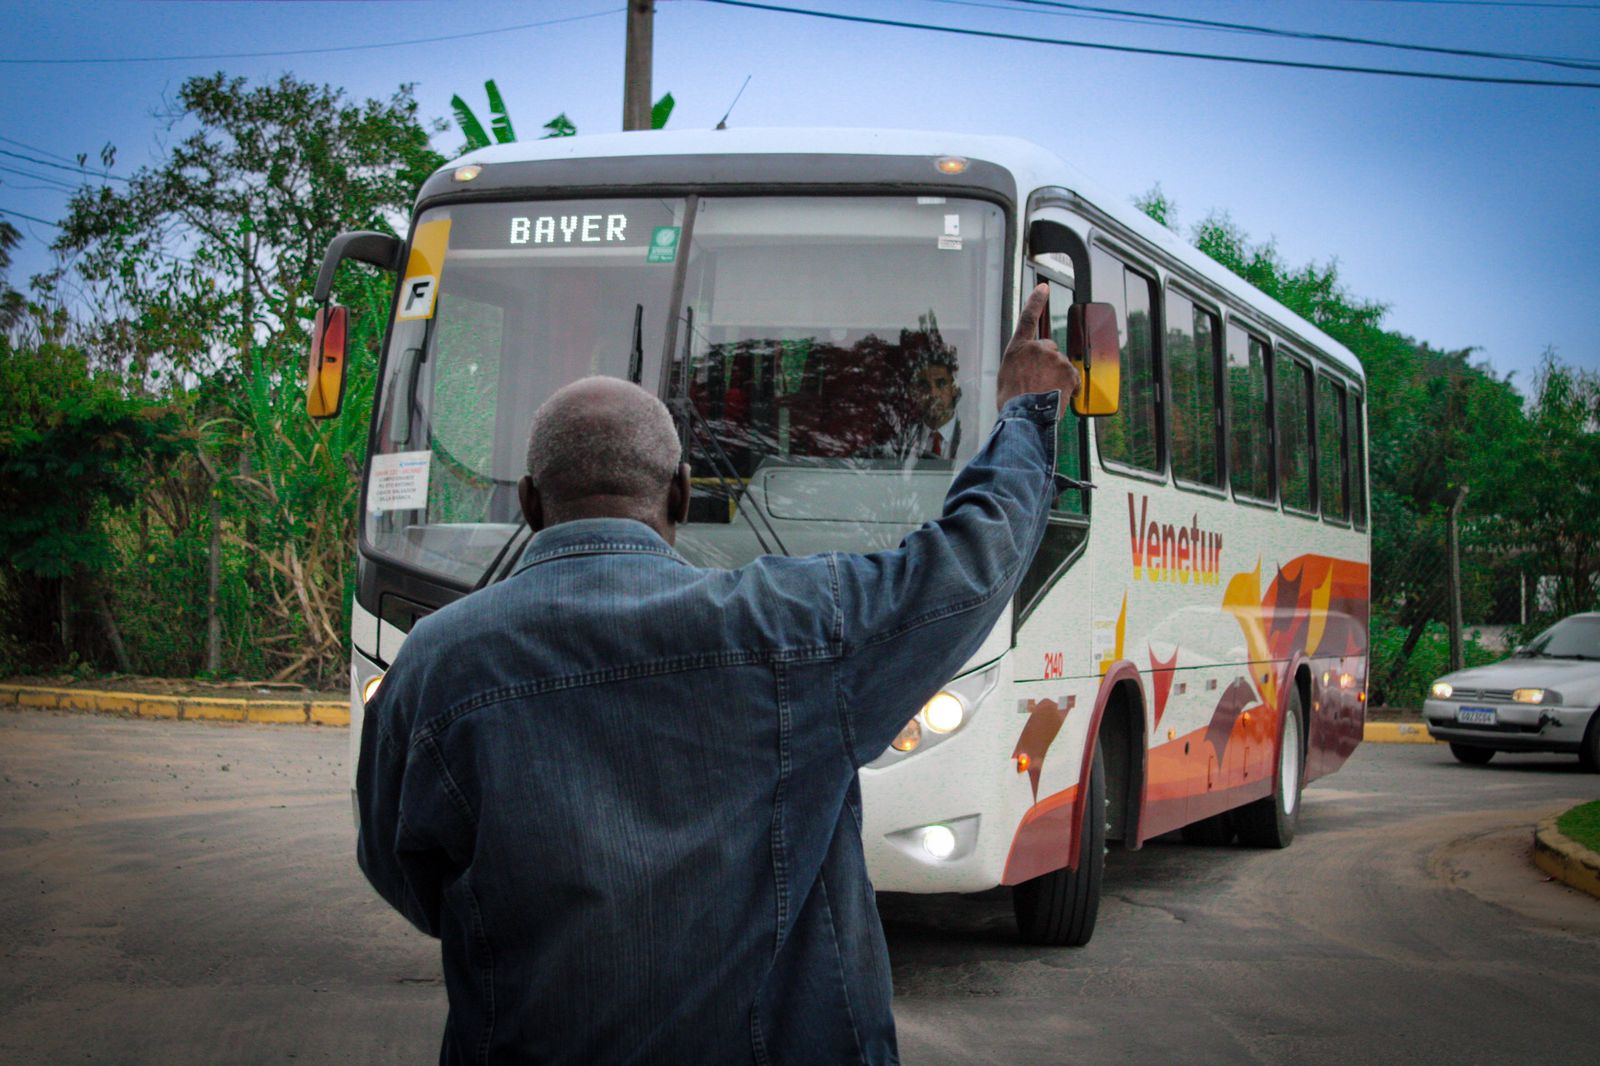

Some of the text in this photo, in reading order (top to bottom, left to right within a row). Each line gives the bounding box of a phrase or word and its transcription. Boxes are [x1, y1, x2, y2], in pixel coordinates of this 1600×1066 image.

[510, 214, 627, 244] BAYER
[405, 281, 430, 311] F
[1128, 492, 1222, 586] Venetur
[1044, 652, 1063, 679] 2140
